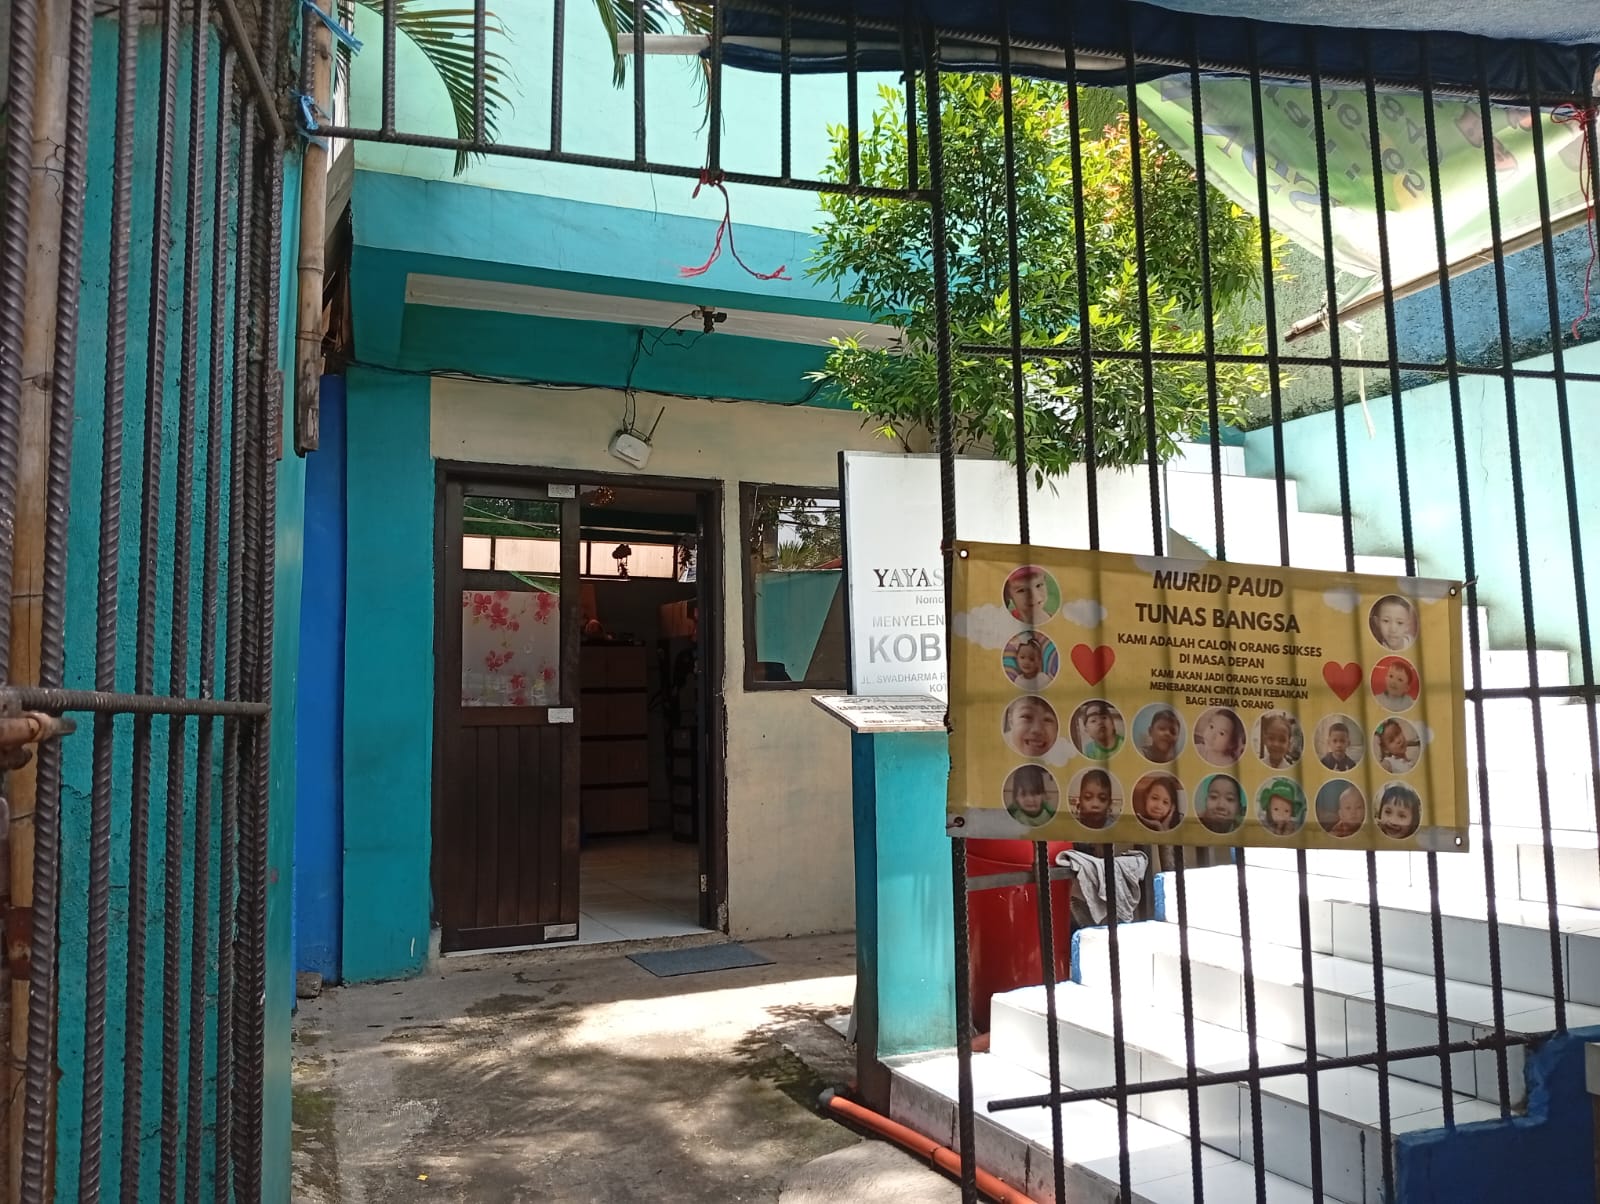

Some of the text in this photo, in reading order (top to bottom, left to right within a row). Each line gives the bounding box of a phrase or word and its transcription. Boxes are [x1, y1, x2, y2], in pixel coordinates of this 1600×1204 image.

[1153, 569, 1284, 598] MURID PAUD
[1135, 603, 1301, 633] TUNAS BANGSA
[869, 633, 942, 663] KOB
[1117, 632, 1322, 658] KAMI ADALAH CALON ORANG SUKSES
[1179, 653, 1265, 669] DI MASA DEPAN
[877, 672, 937, 684] SWADHARMA
[1151, 668, 1307, 687] KAMI AKAN JADI ORANG YG SELALU
[1149, 681, 1309, 700] MENEBARKAN CINTA DAN KEBAIKAN
[1185, 696, 1274, 710] BAGI SEMUA ORANG
